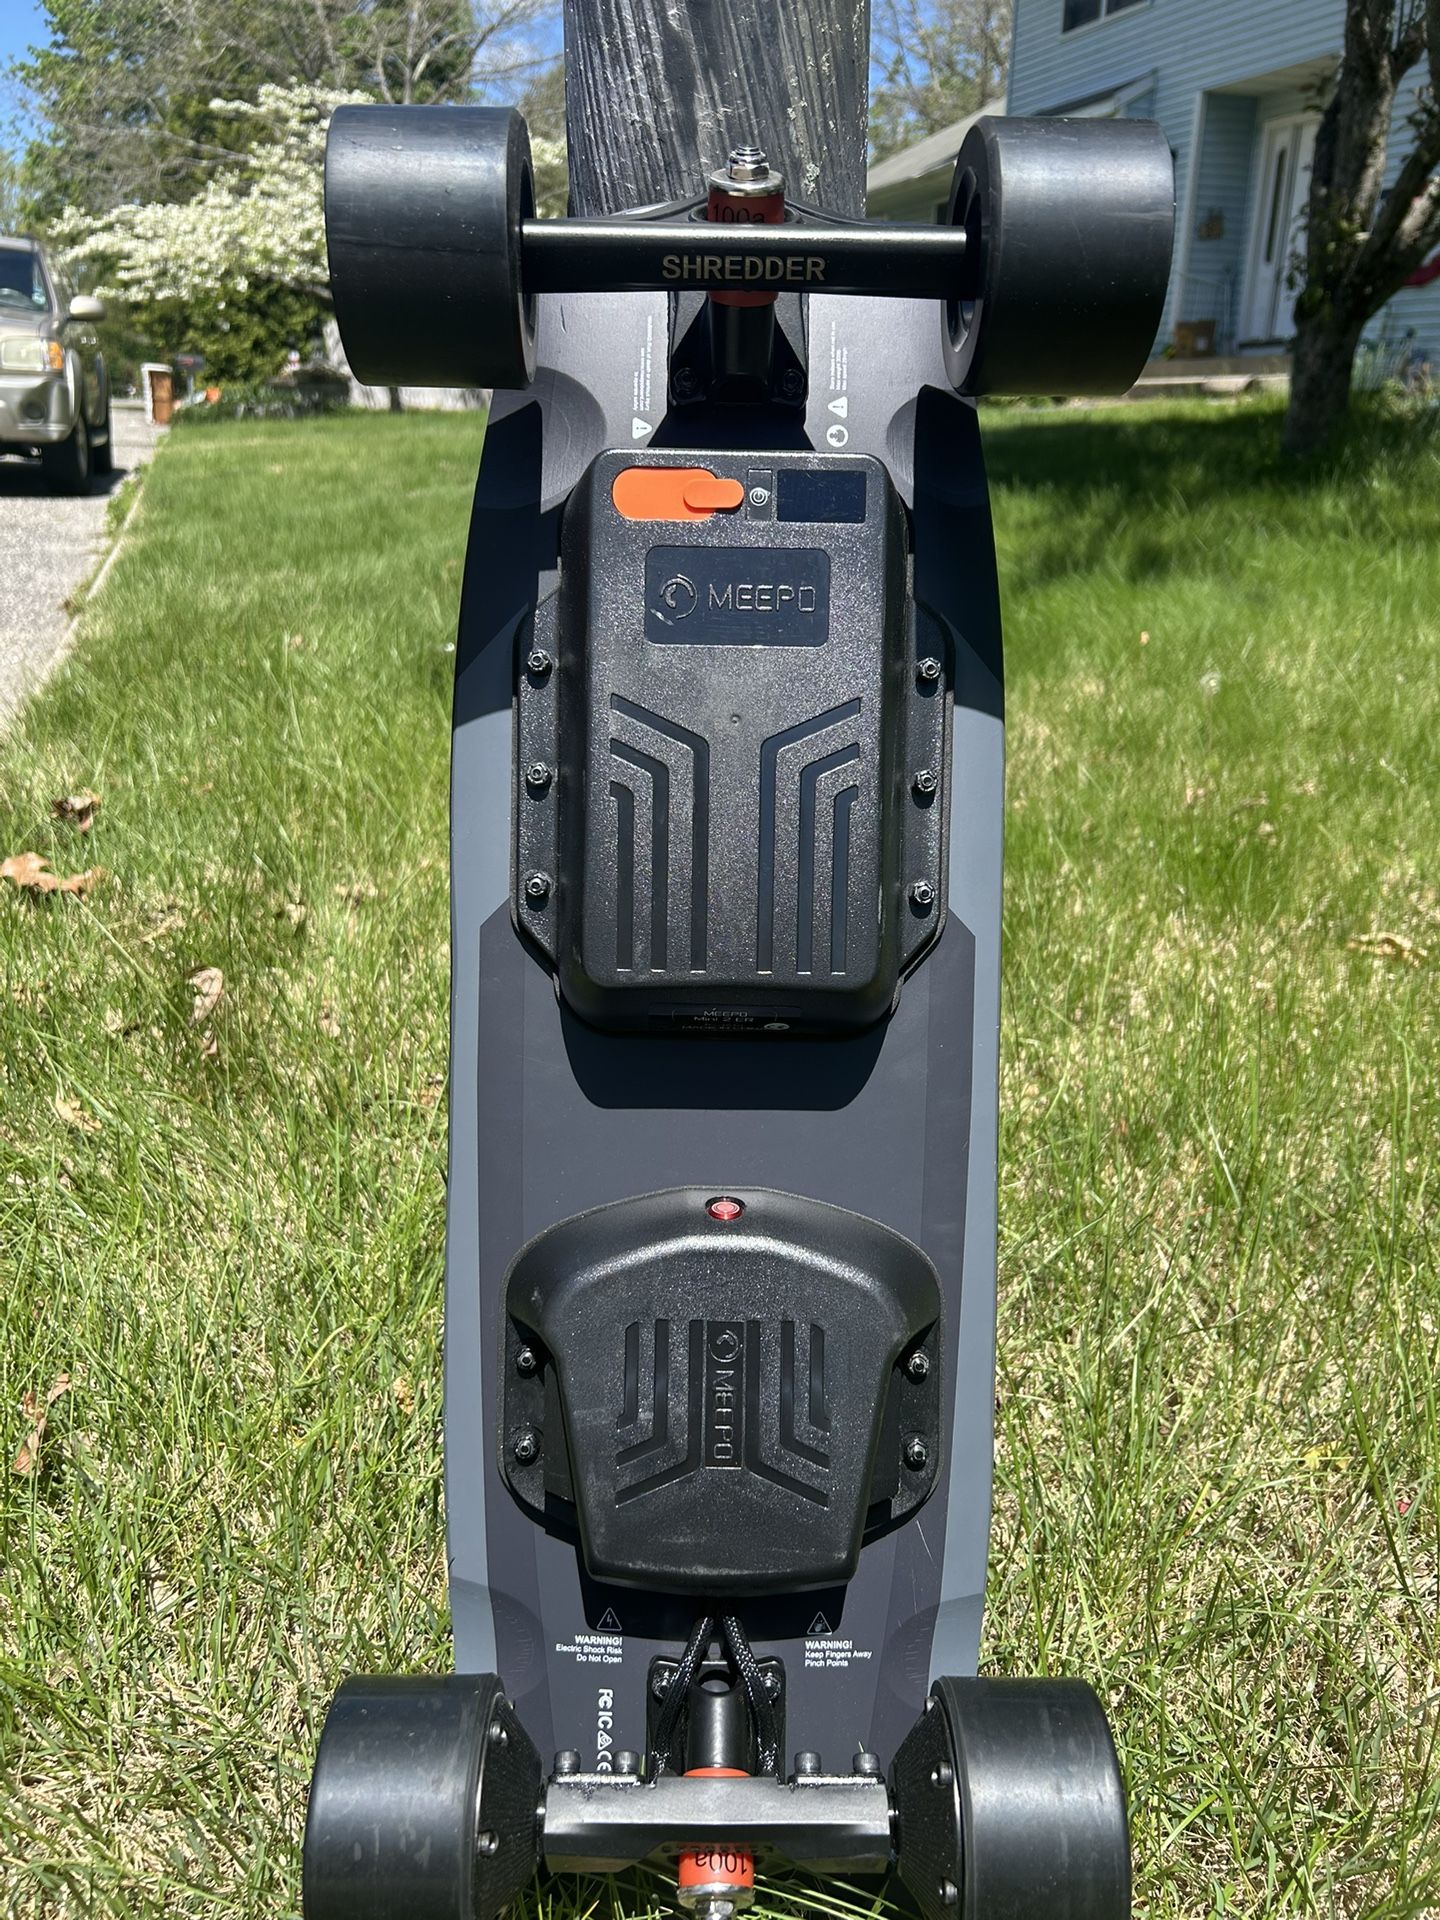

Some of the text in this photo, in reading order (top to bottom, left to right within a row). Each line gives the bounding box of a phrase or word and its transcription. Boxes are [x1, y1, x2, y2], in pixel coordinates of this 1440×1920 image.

[713, 203, 765, 223] 100a
[662, 254, 826, 281] SHREDDER
[708, 584, 816, 612] MEEPO
[713, 1370, 735, 1459] MEEPO
[575, 1635, 623, 1646] WARNING!
[805, 1640, 853, 1650] WARNING!
[556, 1643, 623, 1655] Electric Shock Risk
[805, 1650, 873, 1660] Keep Fingers Away
[576, 1653, 623, 1664] Do Not Open
[804, 1659, 849, 1667] Pinch Points
[695, 1853, 748, 1876] 100a
